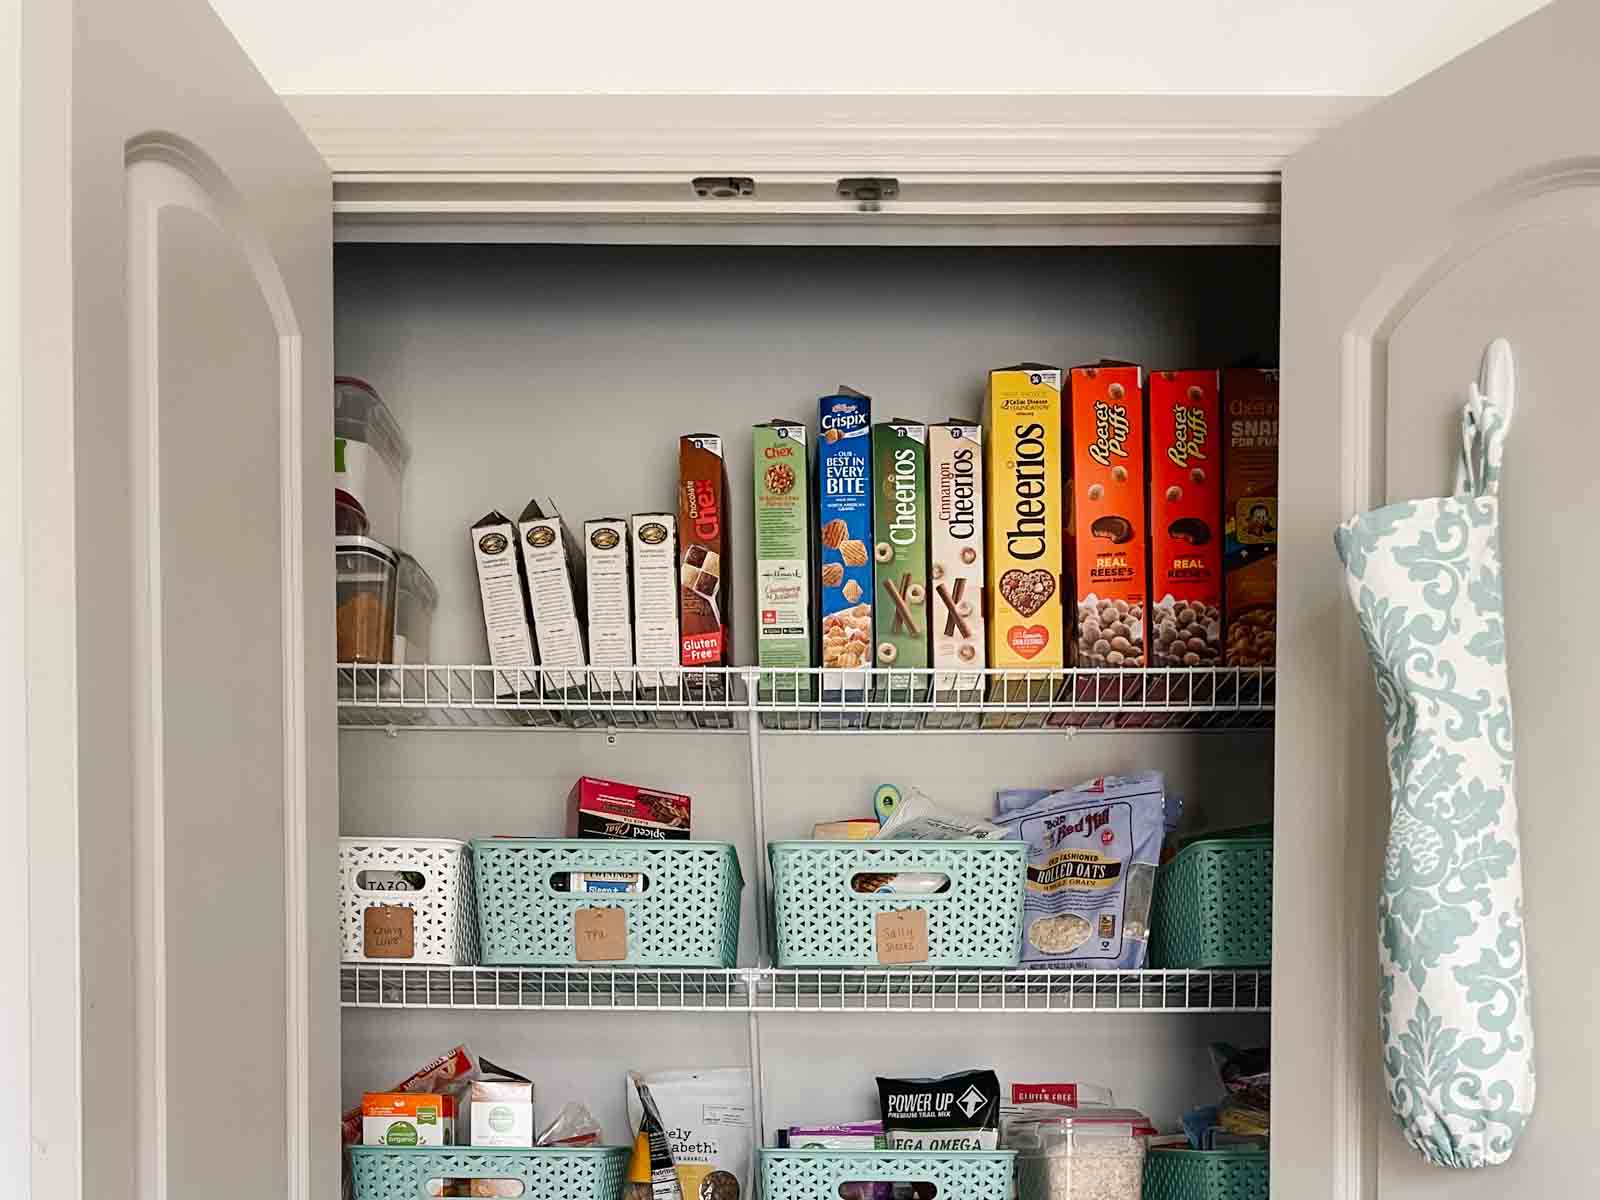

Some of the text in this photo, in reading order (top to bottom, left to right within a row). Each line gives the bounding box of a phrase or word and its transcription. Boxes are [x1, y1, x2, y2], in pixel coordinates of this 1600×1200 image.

[822, 411, 866, 429] Crispix
[1089, 401, 1111, 466] Reese's
[1108, 405, 1128, 457] Puffs
[1168, 404, 1188, 467] Reese's
[1187, 407, 1207, 459] Puffs
[826, 457, 865, 467] BEST IN
[826, 466, 865, 478] EVERY
[826, 478, 865, 495] BITE
[1006, 423, 1046, 561] Cheerios
[889, 448, 917, 545] Cheerios
[949, 449, 975, 540] Cheerios
[1096, 557, 1128, 568] REAL
[1173, 559, 1205, 569] REAL
[1090, 567, 1135, 577] REESE'S
[683, 638, 718, 651] Gluten
[691, 650, 713, 661] Free
[633, 826, 666, 840] Spiced
[1055, 817, 1083, 848] Red
[1060, 853, 1099, 863] FASHIONED
[1037, 862, 1107, 883] ROLLED OATS
[888, 1092, 955, 1113] POWER UP
[938, 1110, 951, 1118] MIX
[671, 1142, 718, 1154] abeth.
[929, 1138, 982, 1150] OMEGA
